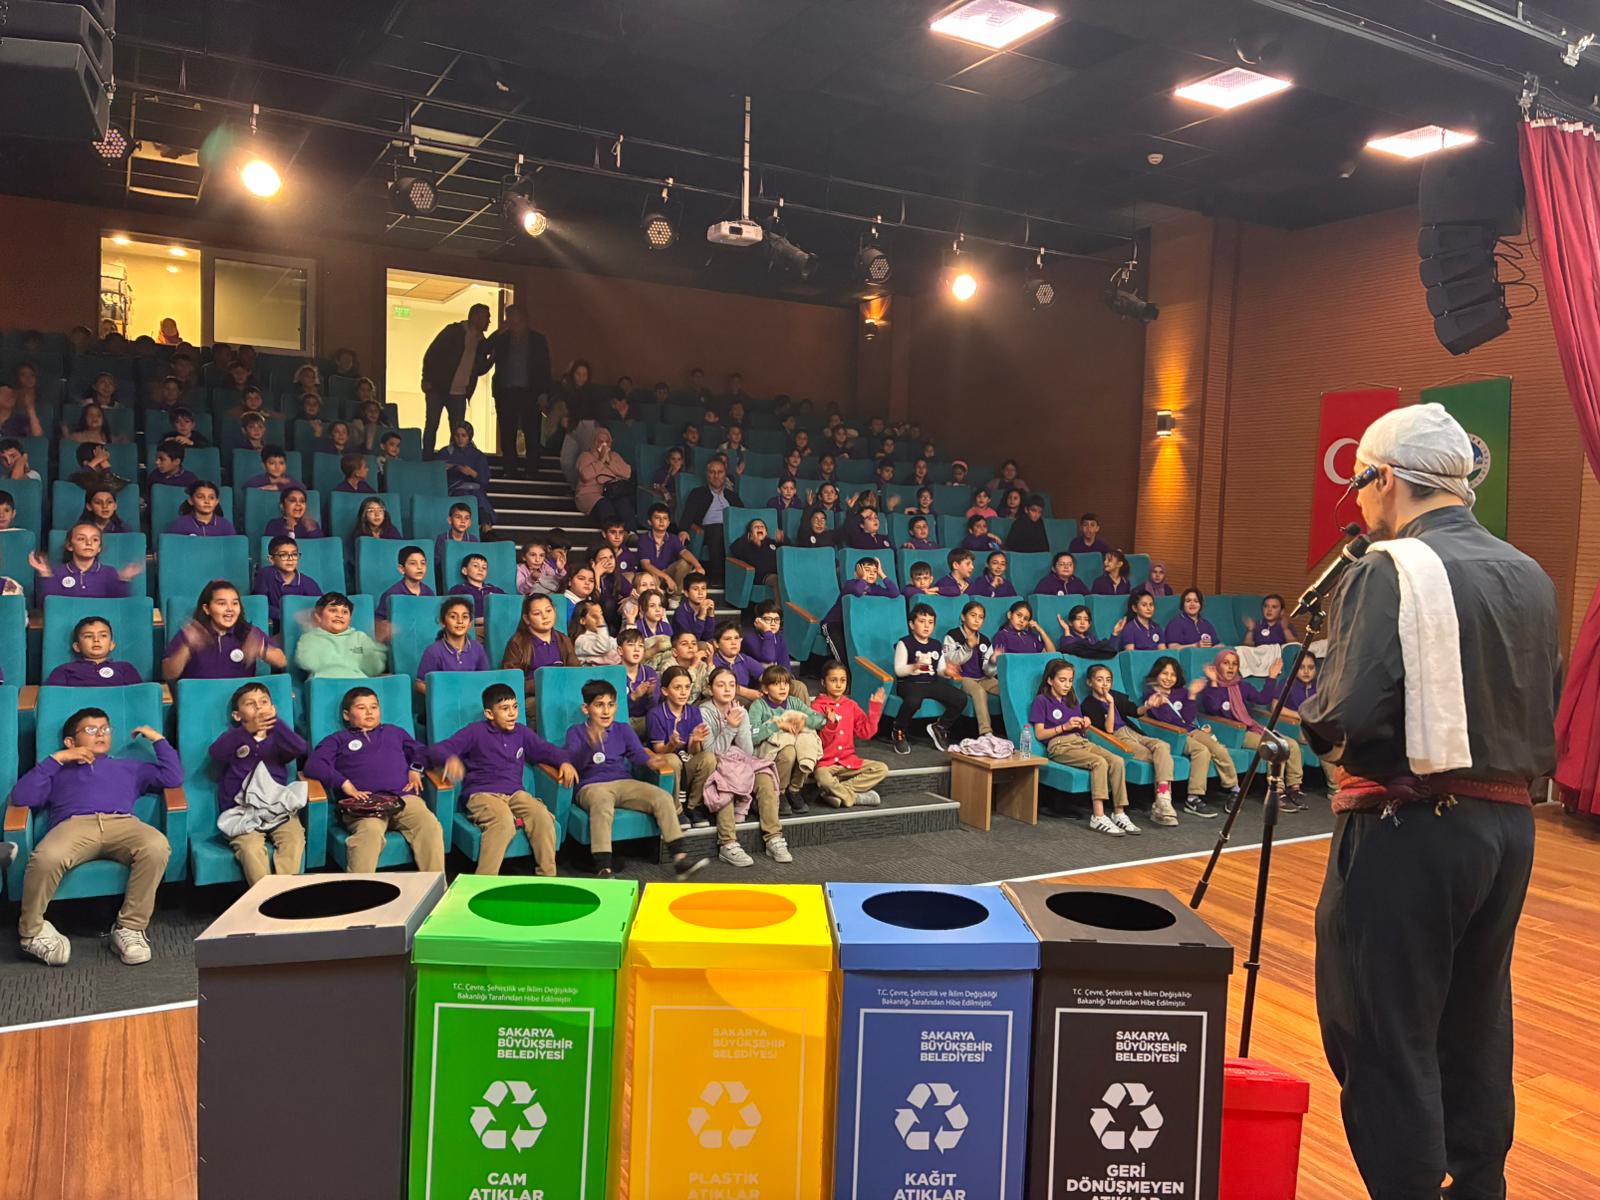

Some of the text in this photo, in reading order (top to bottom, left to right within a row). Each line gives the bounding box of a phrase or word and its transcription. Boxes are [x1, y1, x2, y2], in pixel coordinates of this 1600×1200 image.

[949, 989, 964, 997] İklim
[1143, 989, 1159, 997] İklim
[498, 1027, 555, 1038] SAKARYA
[713, 1028, 768, 1037] SAKARYA
[921, 1031, 975, 1041] SAKARYA
[1116, 1031, 1170, 1041] SAKARYA
[497, 1037, 573, 1049] BÜYÜKŞEHİR
[920, 1040, 993, 1052] BÜYÜKŞEHİR
[1115, 1040, 1188, 1053] BÜYÜKŞEHİR
[497, 1049, 564, 1060] BELEDİYESİ
[920, 1051, 985, 1063] BELEDİYESİ
[1115, 1052, 1180, 1063] BELEDİYESİ
[1106, 1162, 1146, 1178] GERİ
[487, 1172, 527, 1186] CAM
[689, 1169, 759, 1185] PLASTİK
[904, 1170, 957, 1186] KAĞIT
[1066, 1176, 1185, 1195] DÖNÜŞMEYEN
[469, 1188, 544, 1200] ATIKLAR
[893, 1188, 966, 1200] ATIKLAR
